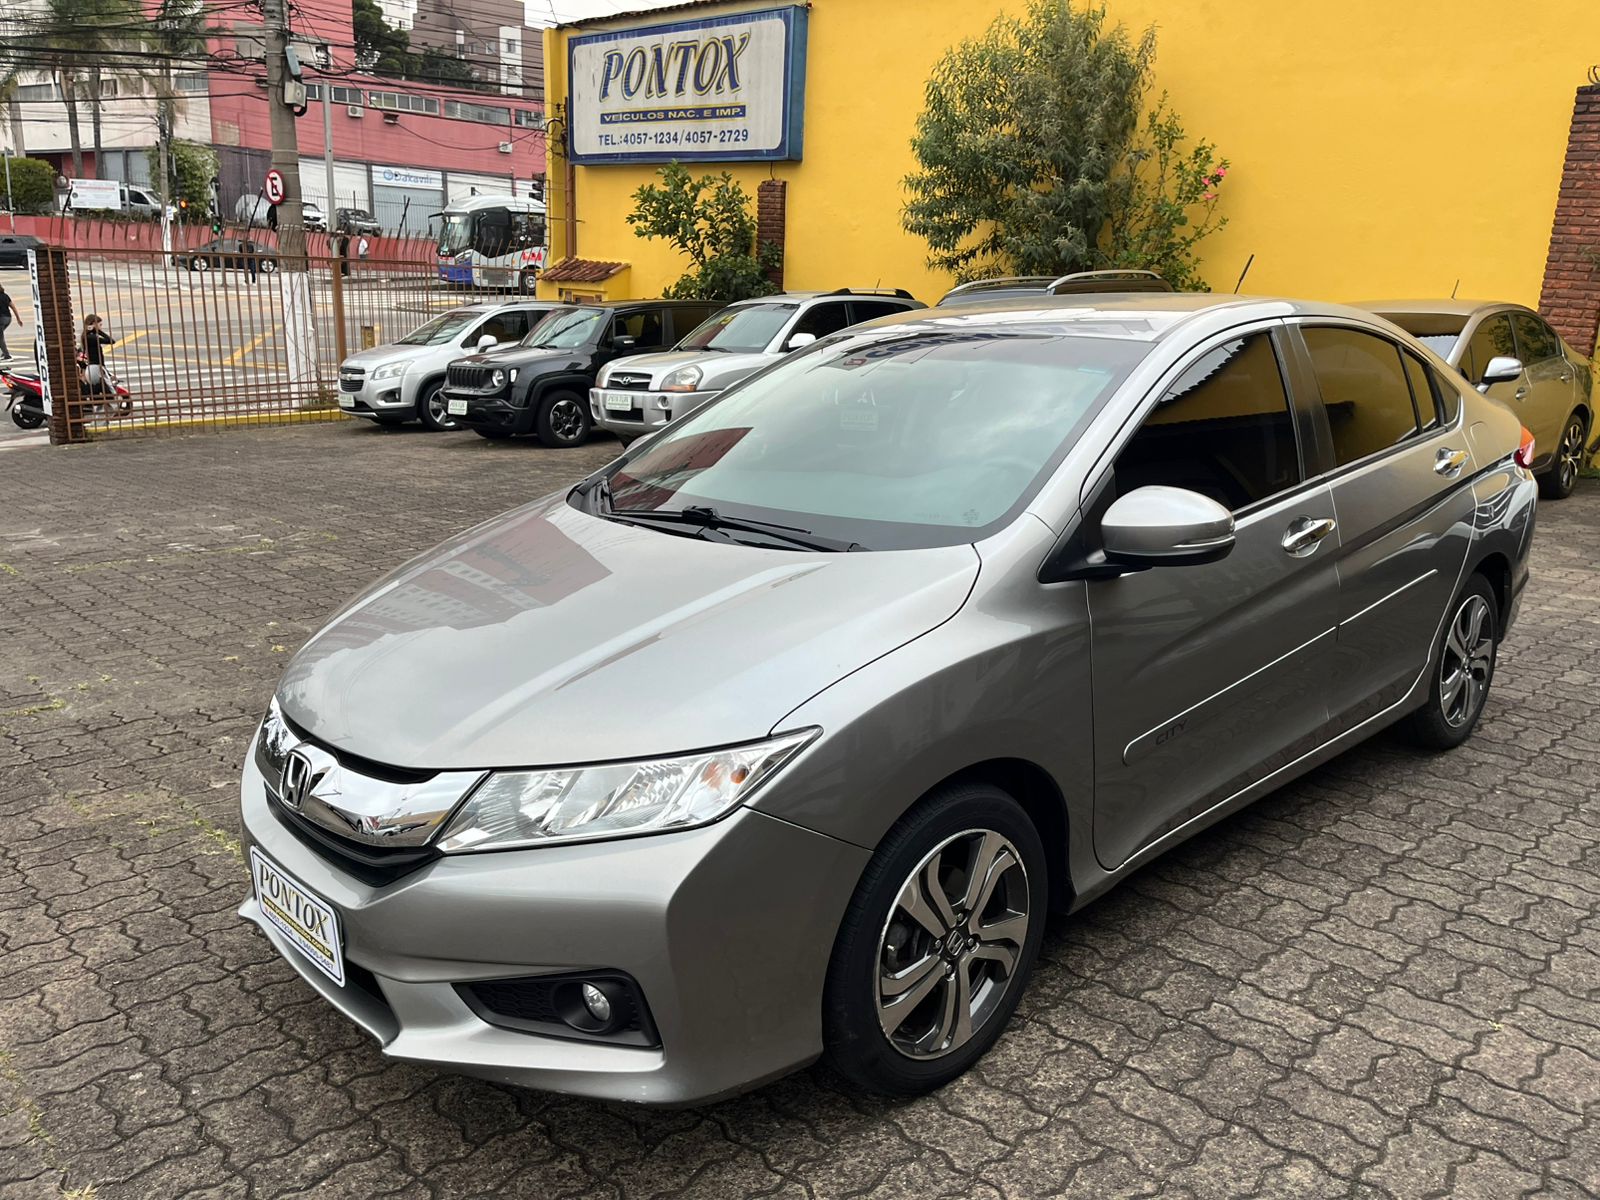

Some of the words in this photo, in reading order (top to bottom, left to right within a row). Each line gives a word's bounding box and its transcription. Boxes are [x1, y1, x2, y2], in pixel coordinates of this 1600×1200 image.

[600, 32, 751, 102] PONTOX
[668, 109, 700, 119] NAC.
[703, 109, 712, 117] E
[716, 107, 743, 116] IMP.
[31, 263, 51, 402] ENTRADA
[1156, 718, 1188, 745] CITY
[259, 861, 329, 944] PONTOX
